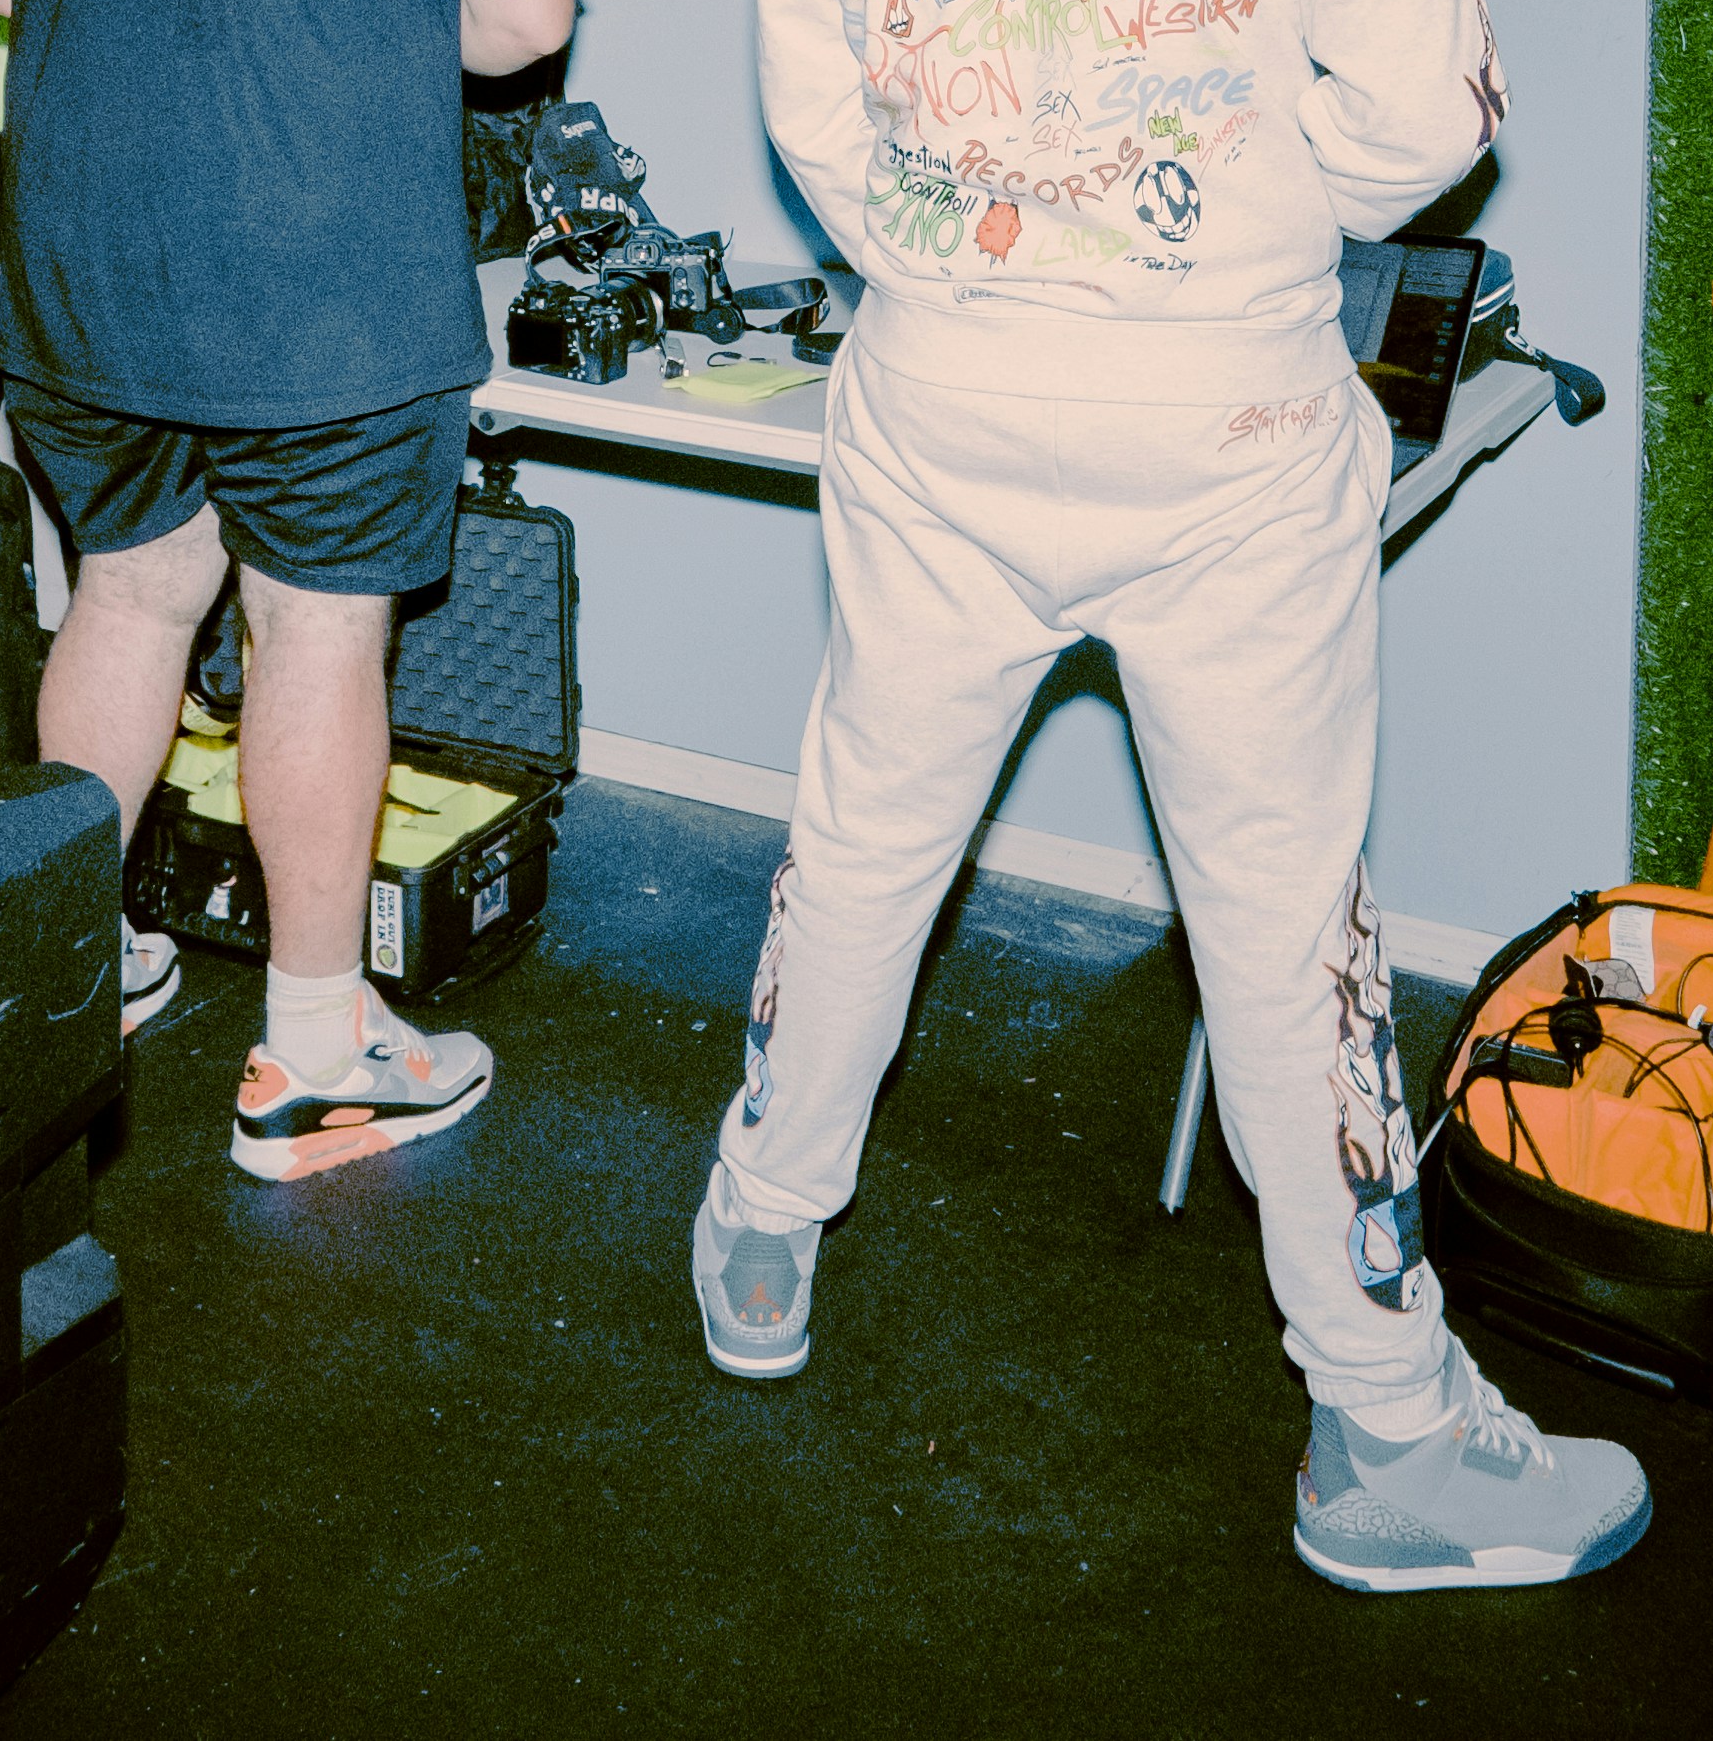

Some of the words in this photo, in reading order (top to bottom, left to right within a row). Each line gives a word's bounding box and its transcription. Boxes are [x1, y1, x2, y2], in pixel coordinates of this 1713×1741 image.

[1031, 89, 1082, 127] SEX
[1083, 65, 1257, 135] SPACE
[1024, 120, 1083, 161] SEX
[1147, 106, 1183, 139] NEW
[954, 136, 1144, 212] RECORDS
